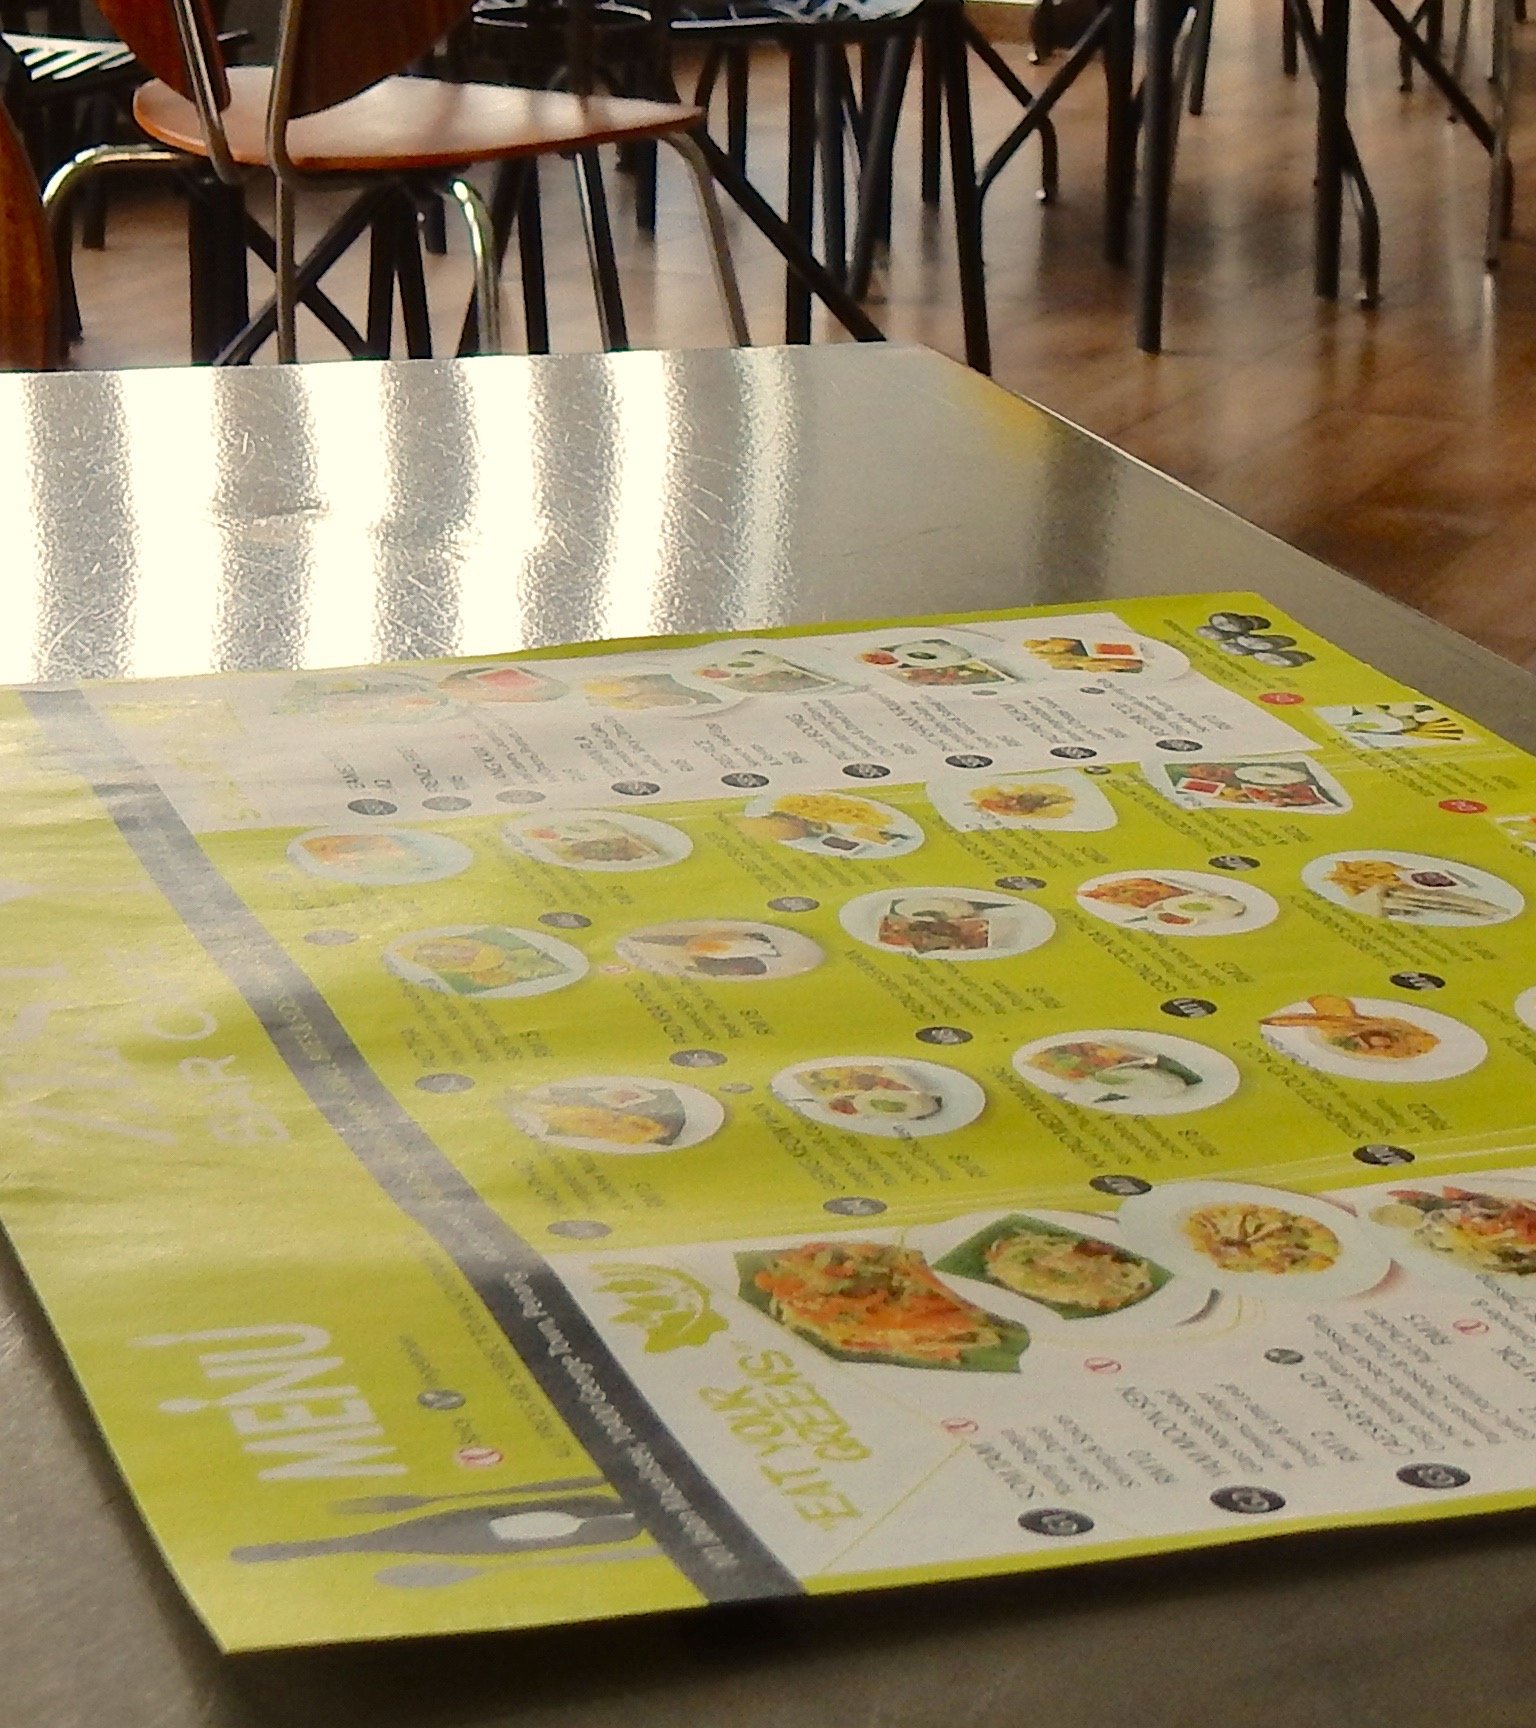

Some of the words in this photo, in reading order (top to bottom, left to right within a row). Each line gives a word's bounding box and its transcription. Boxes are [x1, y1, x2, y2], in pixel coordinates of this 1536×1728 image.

[177, 1055, 290, 1144] BAR
[128, 1322, 408, 1480] MENU
[548, 1352, 619, 1404] George
[698, 1384, 802, 1456] YOUR
